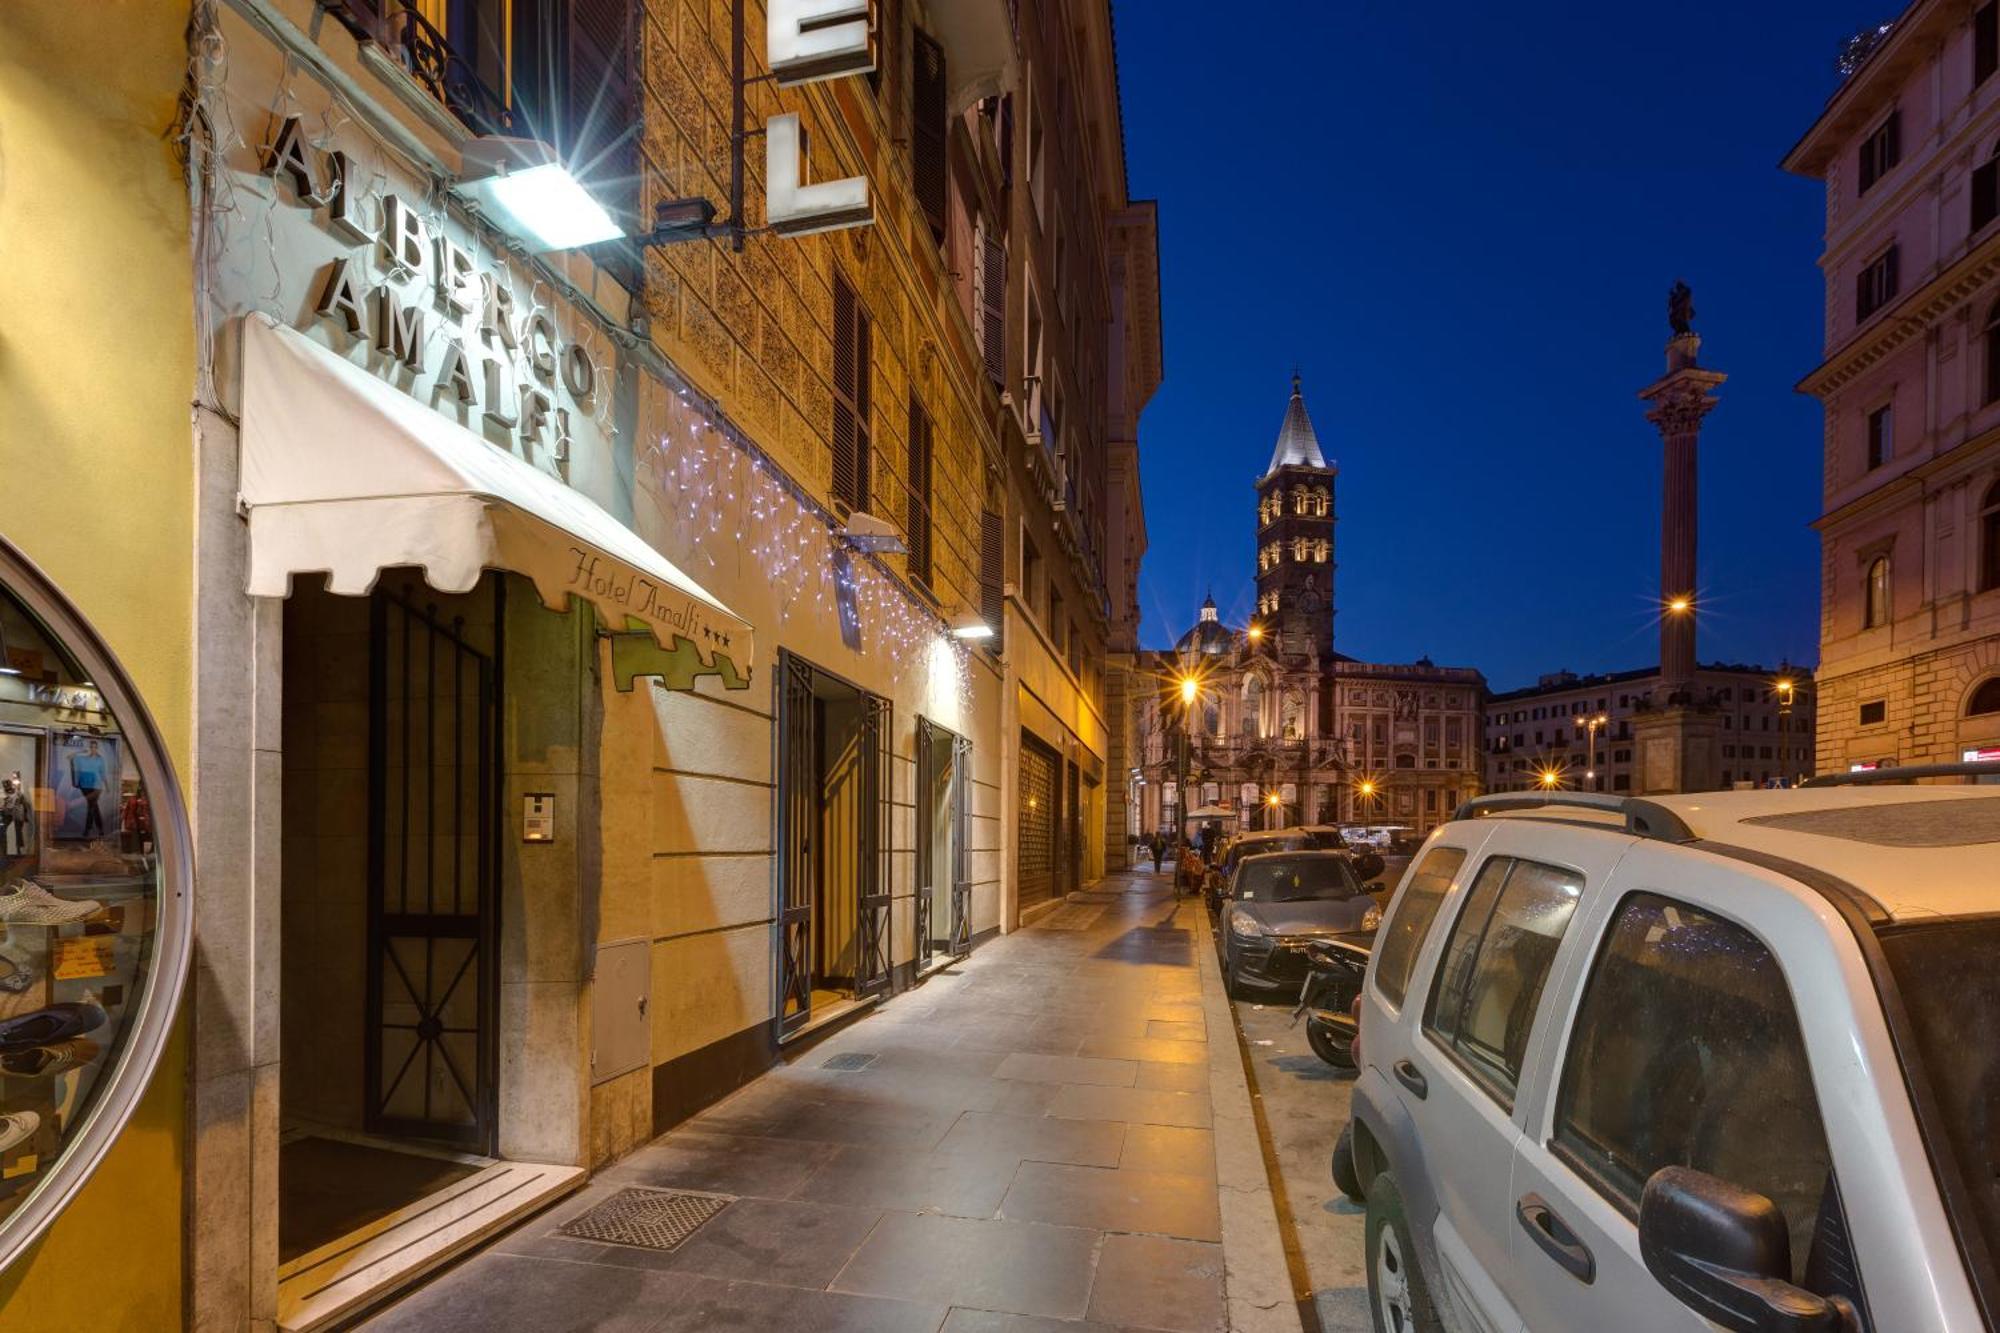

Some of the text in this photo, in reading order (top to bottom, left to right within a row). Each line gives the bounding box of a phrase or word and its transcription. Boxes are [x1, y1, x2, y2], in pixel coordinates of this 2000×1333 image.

[257, 114, 600, 400] ALBERGO
[315, 256, 571, 463] AMALFI
[569, 547, 702, 638] Hotel Amalfi
